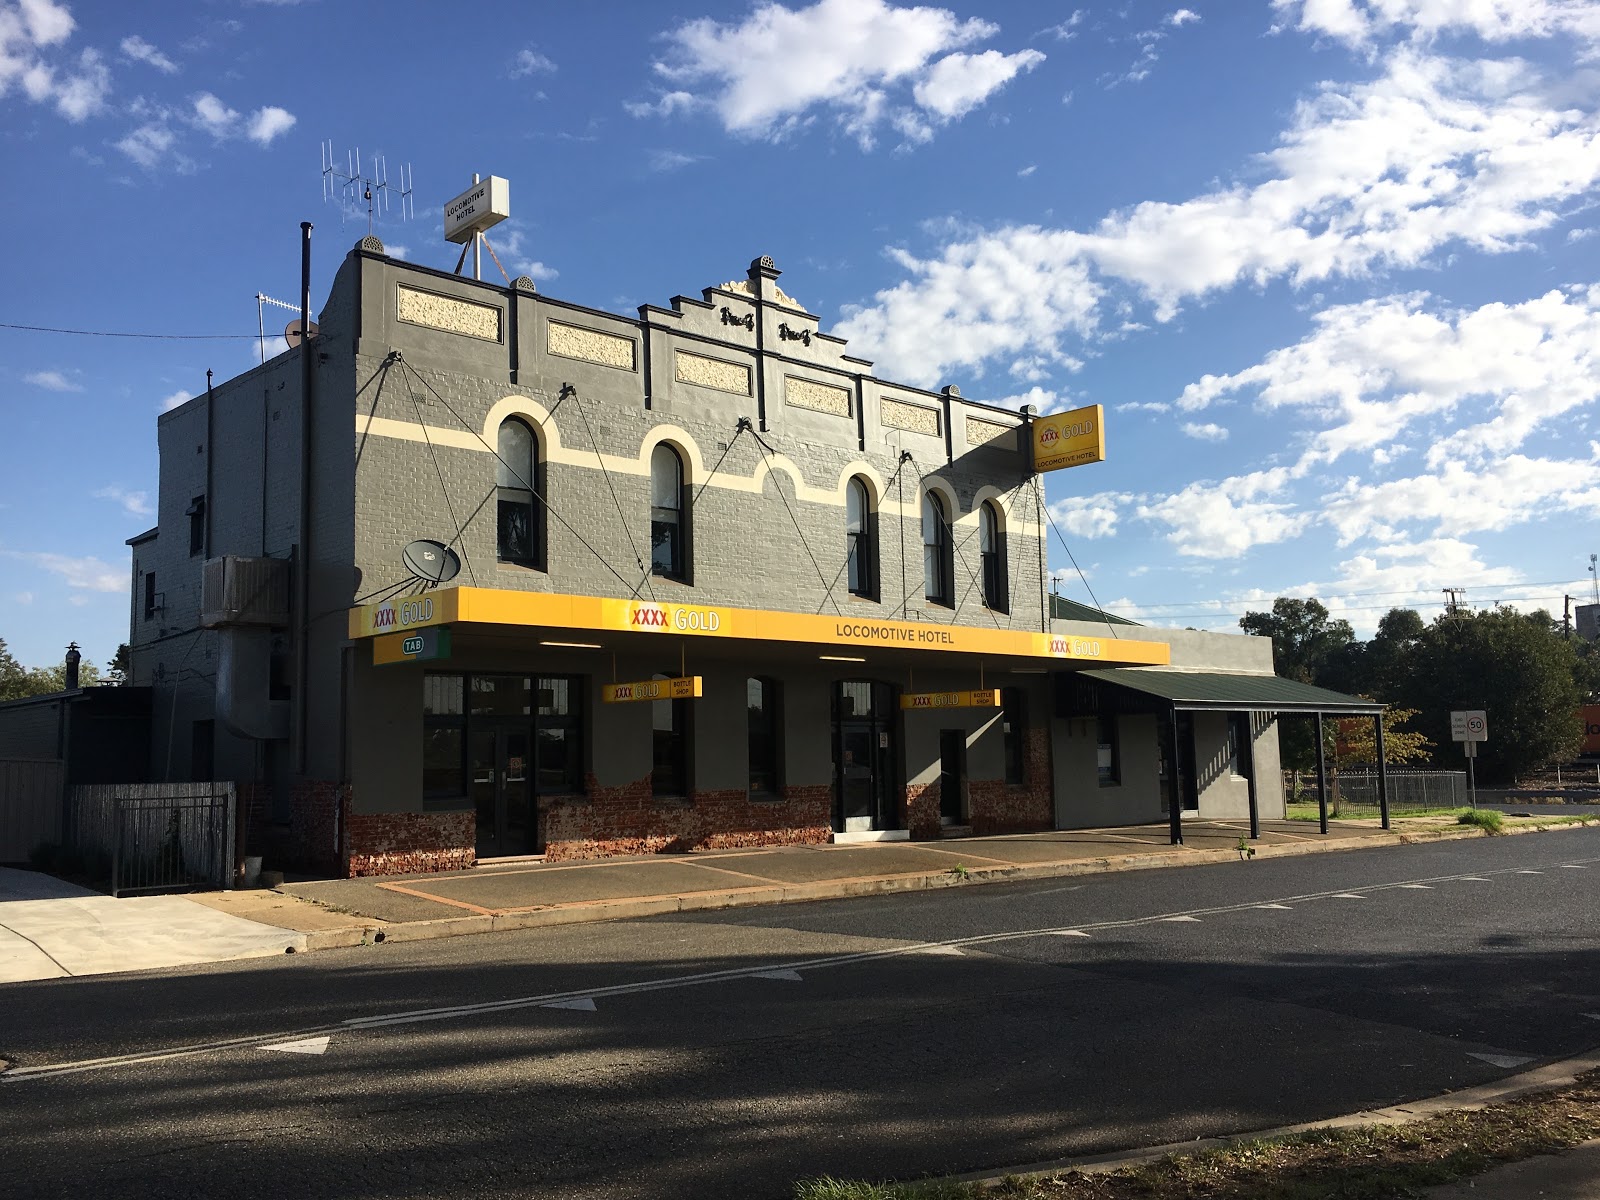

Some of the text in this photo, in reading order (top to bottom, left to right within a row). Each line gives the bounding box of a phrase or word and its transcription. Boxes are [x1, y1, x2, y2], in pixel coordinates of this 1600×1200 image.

[447, 188, 485, 217] LOCOMOTIVE
[456, 205, 475, 221] HOTEL
[1040, 420, 1093, 443] XXXX GOLD
[1037, 451, 1096, 468] LOCOMOTIVE HOTEL
[373, 597, 433, 628] XXXX GOLD
[631, 608, 720, 631] XXXX GOLD
[836, 623, 955, 644] LOCOMOTIVE HOTEL
[405, 640, 421, 651] TAB
[1049, 639, 1100, 657] XXXX GOLD
[614, 682, 659, 699] XXXX GOLD
[673, 680, 691, 688] BOTTLE
[675, 688, 689, 696] SHOP
[912, 693, 959, 707] XXXX GOLD
[1470, 721, 1482, 729] 50
